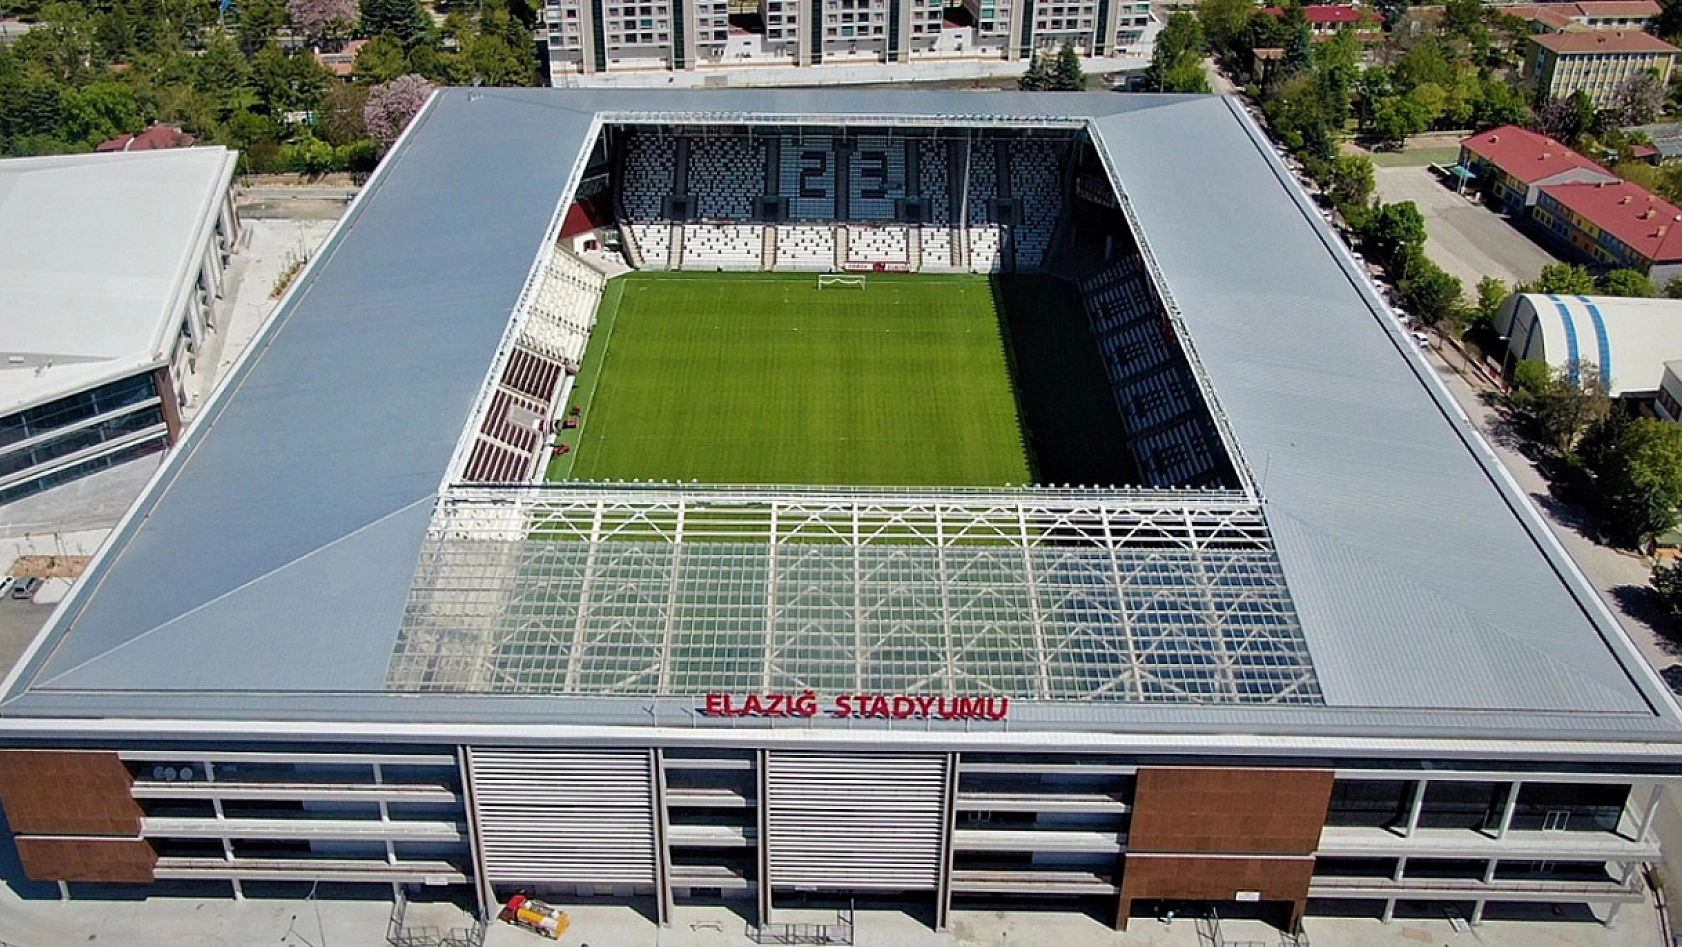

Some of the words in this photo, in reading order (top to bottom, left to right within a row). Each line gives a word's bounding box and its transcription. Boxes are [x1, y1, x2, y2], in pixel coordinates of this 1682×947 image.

[800, 151, 888, 198] 23
[705, 690, 816, 717] ELAZIĞ
[835, 694, 1009, 720] STADYUMU
